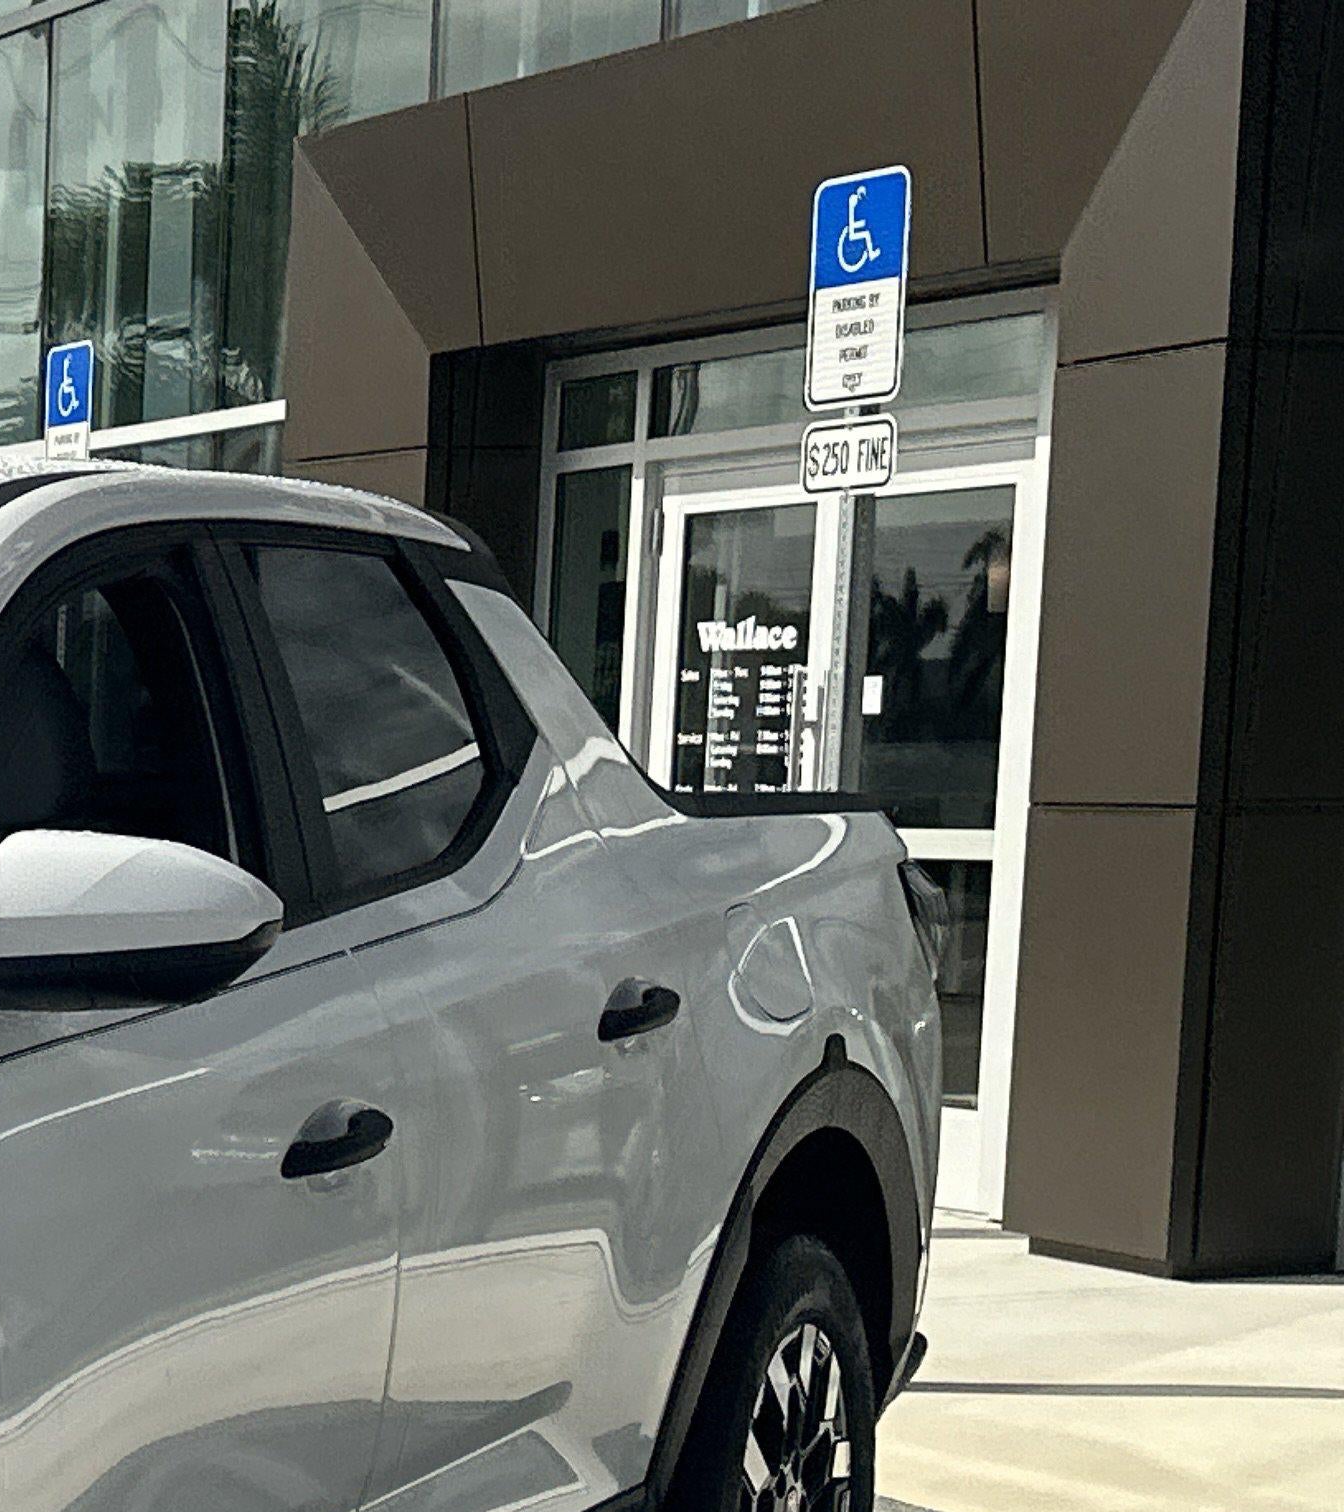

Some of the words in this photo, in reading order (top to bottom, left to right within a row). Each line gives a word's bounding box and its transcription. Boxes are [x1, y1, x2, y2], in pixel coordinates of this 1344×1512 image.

[808, 440, 849, 480] $250
[857, 437, 889, 472] FINE
[697, 615, 798, 652] Wallace
